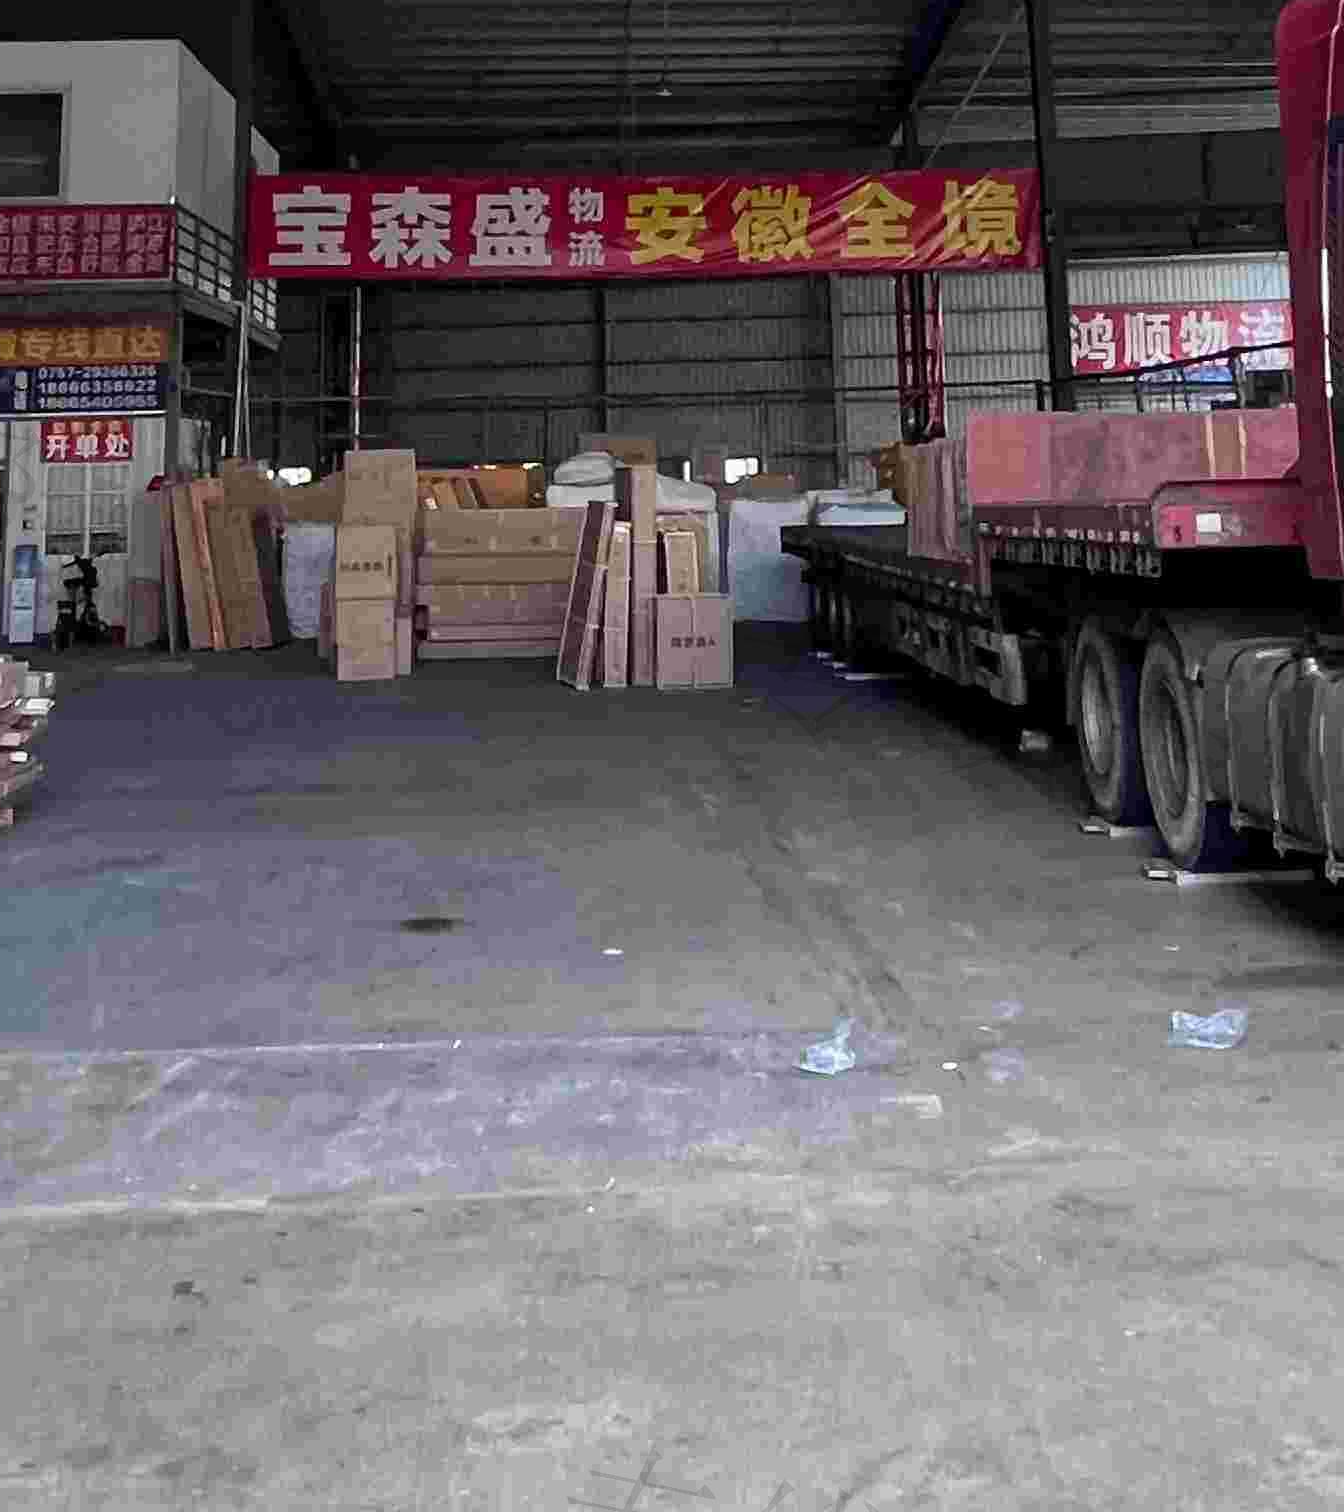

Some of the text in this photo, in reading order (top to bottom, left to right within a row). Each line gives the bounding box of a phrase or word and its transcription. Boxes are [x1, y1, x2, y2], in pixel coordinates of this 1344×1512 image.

[268, 185, 553, 269] 宝森盛
[569, 186, 606, 268] 物流
[625, 179, 1022, 264] 安徽全境
